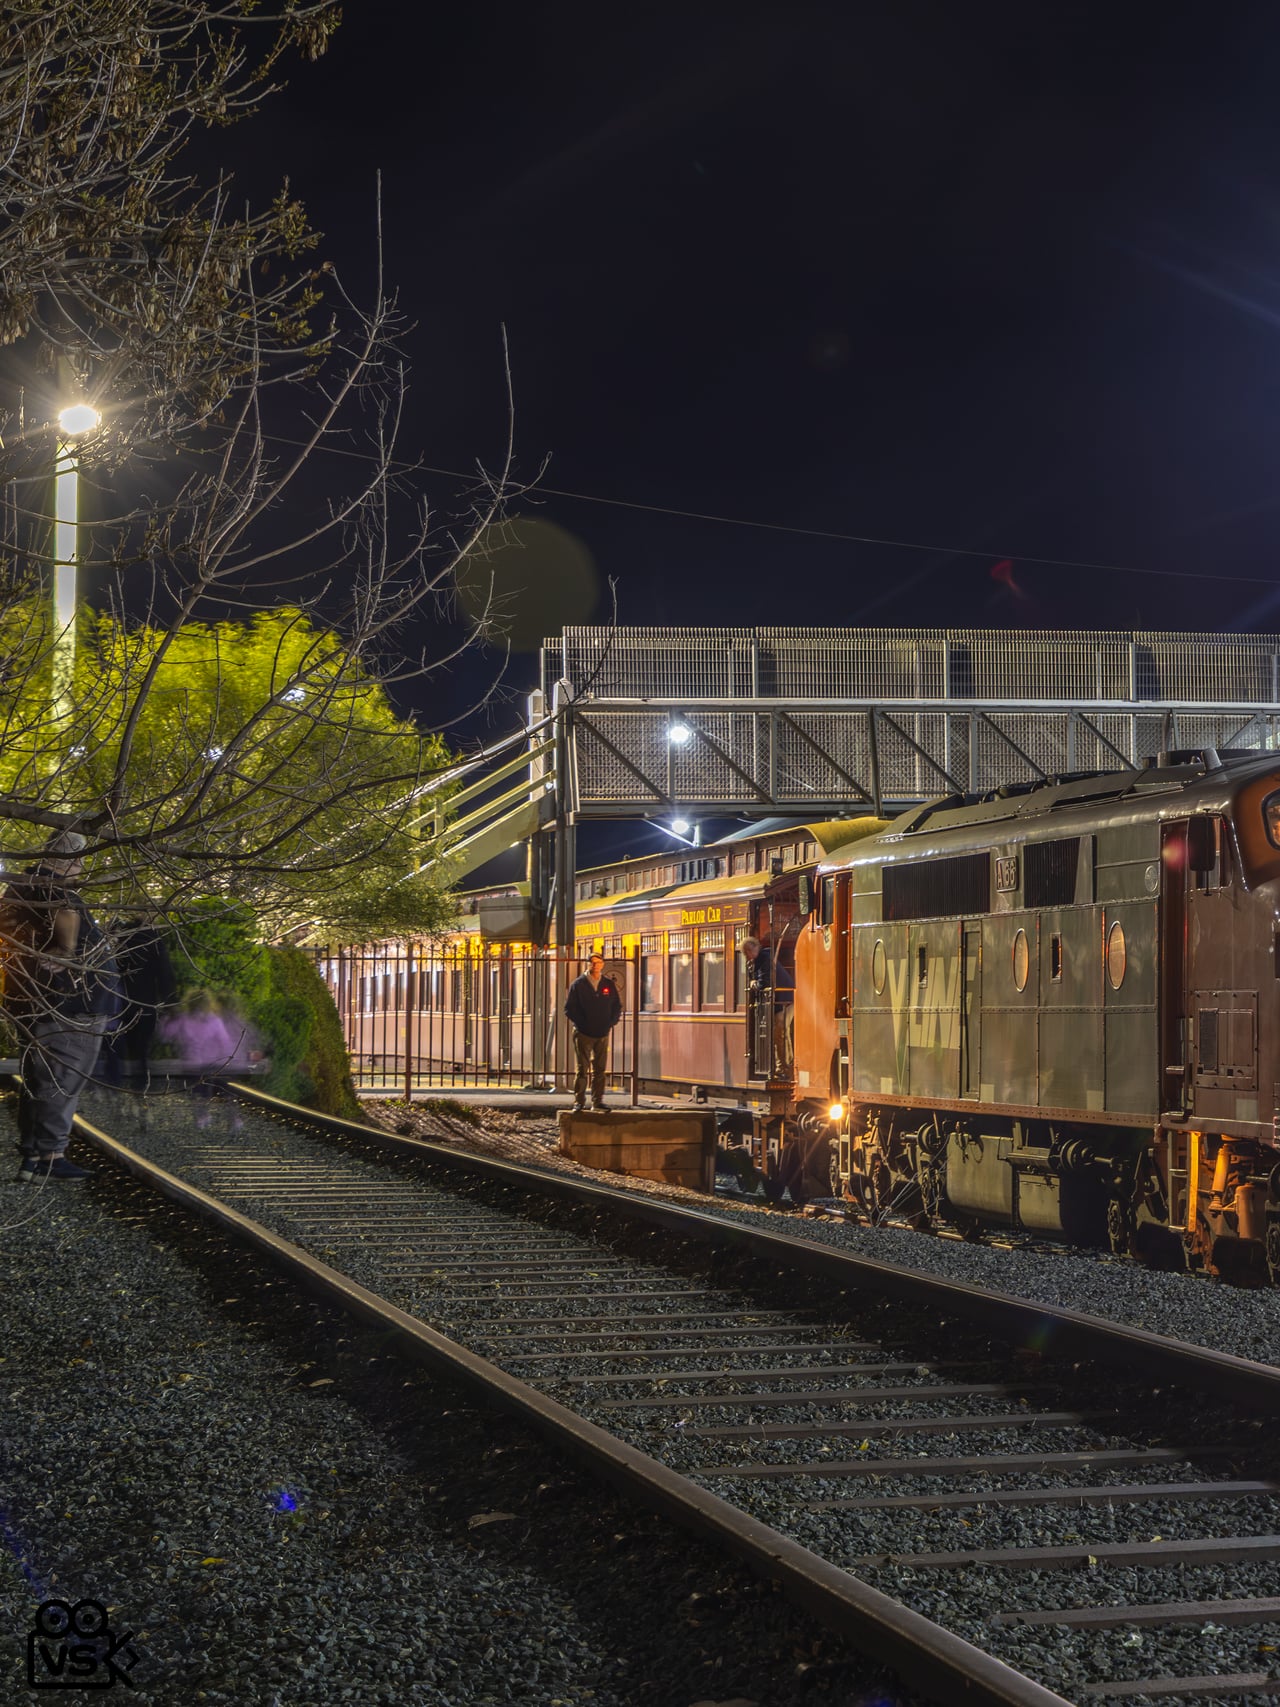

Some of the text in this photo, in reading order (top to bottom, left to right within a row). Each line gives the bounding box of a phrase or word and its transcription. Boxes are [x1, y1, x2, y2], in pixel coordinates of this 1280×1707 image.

[997, 861, 1016, 888] A 66
[681, 906, 721, 925] PARLOR CAR
